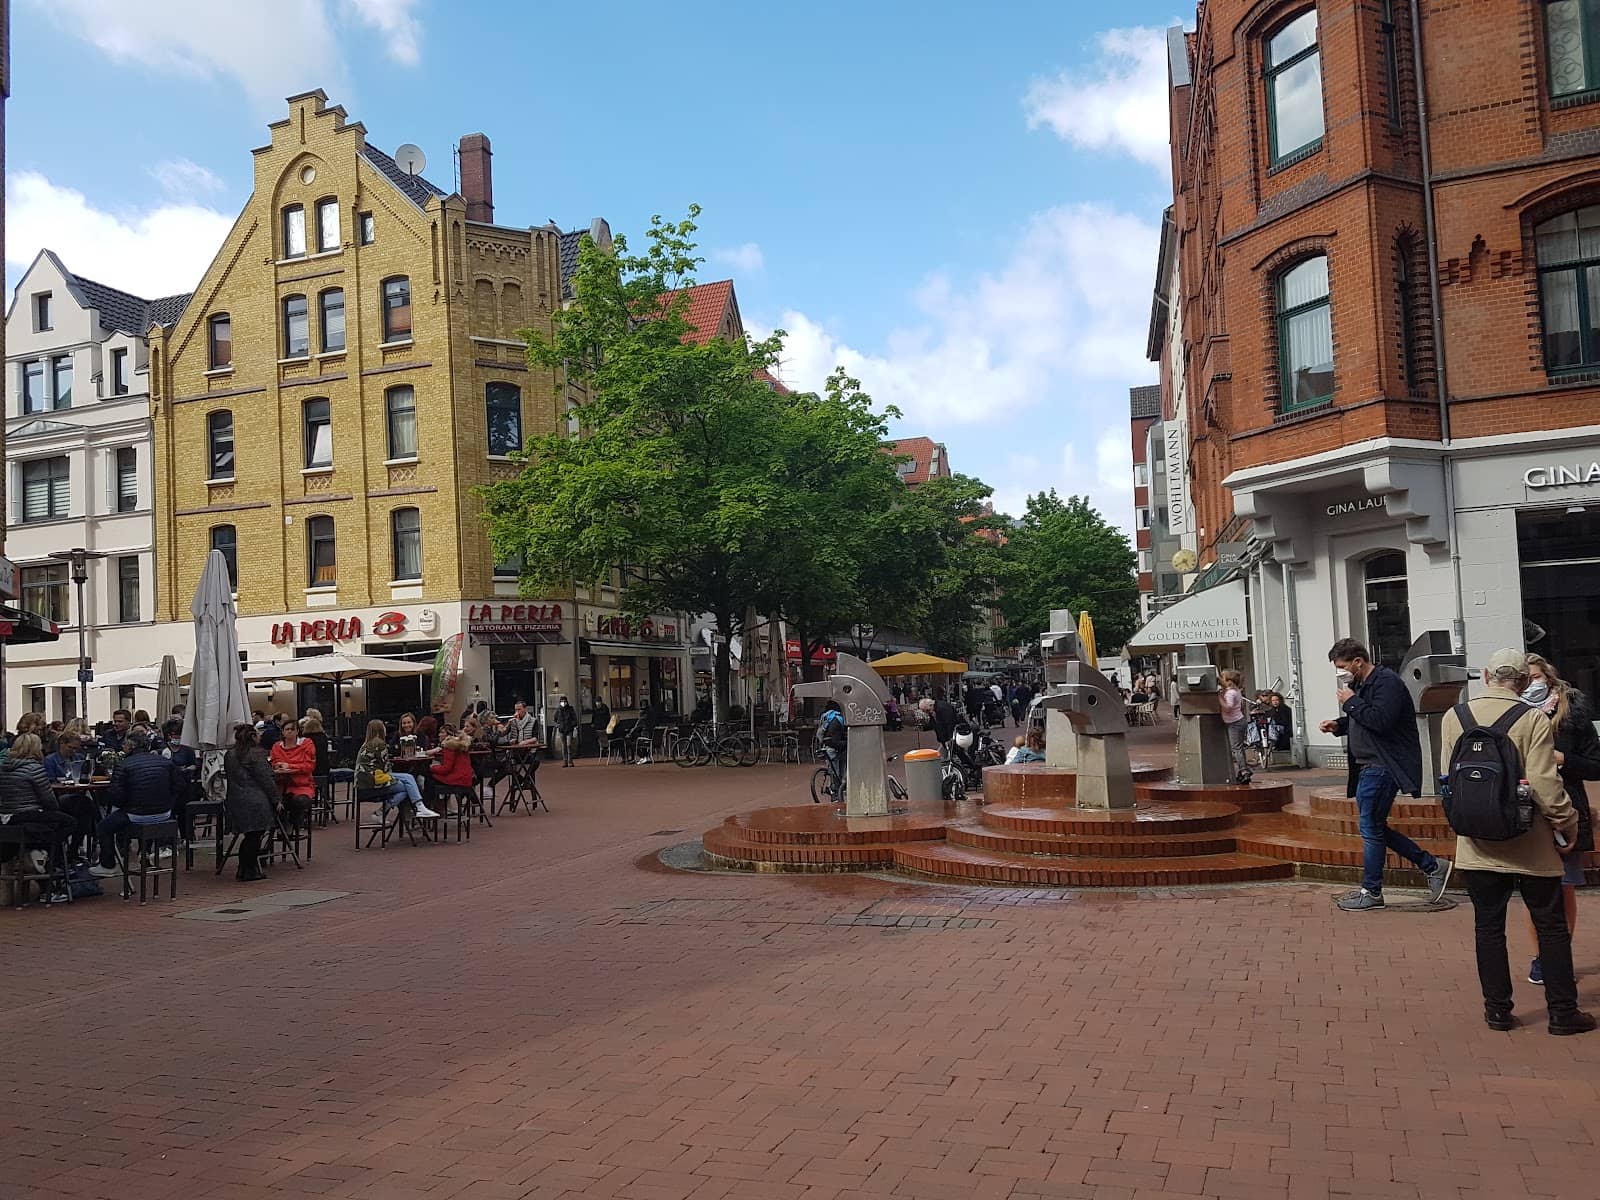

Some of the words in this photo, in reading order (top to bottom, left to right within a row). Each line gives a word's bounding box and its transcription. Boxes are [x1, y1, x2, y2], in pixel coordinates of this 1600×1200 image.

[1168, 429, 1183, 527] WOHLTMANN
[1524, 462, 1600, 487] GINA
[1326, 502, 1356, 516] GINA
[469, 604, 492, 622] LA
[501, 604, 562, 623] PERLA
[1166, 617, 1240, 629] UHRMACHER
[271, 622, 294, 644] LA
[300, 616, 361, 643] PERLA
[1147, 629, 1241, 641] GOLDSCHMIEDE
